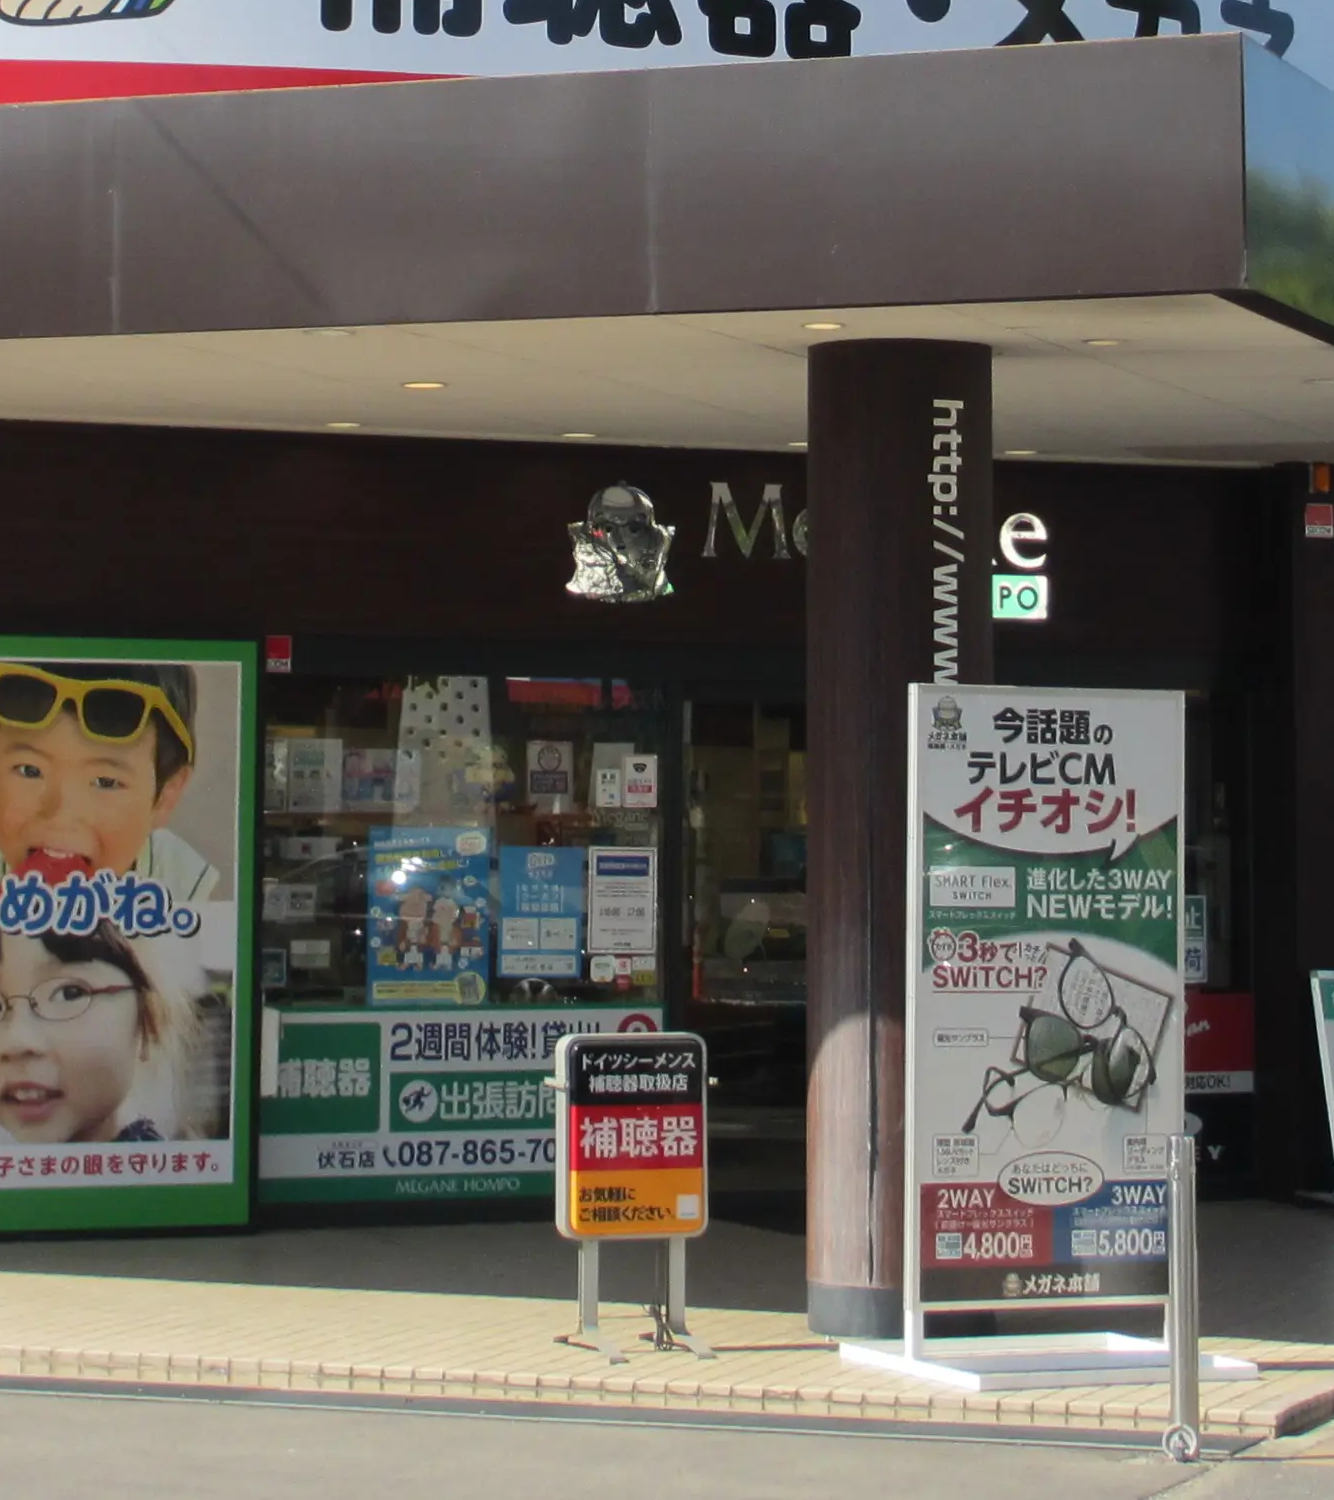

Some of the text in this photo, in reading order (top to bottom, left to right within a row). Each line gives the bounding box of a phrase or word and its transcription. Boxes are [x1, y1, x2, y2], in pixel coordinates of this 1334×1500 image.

[992, 706, 1114, 746] 今話題の
[966, 751, 1117, 785] テレビCM
[953, 786, 1137, 834] イチオシ!
[1026, 867, 1173, 891] 進化した3WAY
[1026, 894, 1173, 920] NEWモデル!
[580, 1052, 697, 1072] ドイツシーメンス
[588, 1073, 689, 1094] 補聴器取扱店
[579, 1115, 699, 1159] 補聴器
[318, 1151, 375, 1169] 伏石店
[578, 1185, 636, 1202] お気軽に
[936, 1187, 996, 1209] 2WAY
[1110, 1185, 1167, 1206] 3WAY
[1022, 1272, 1101, 1295] メガネ本舗
